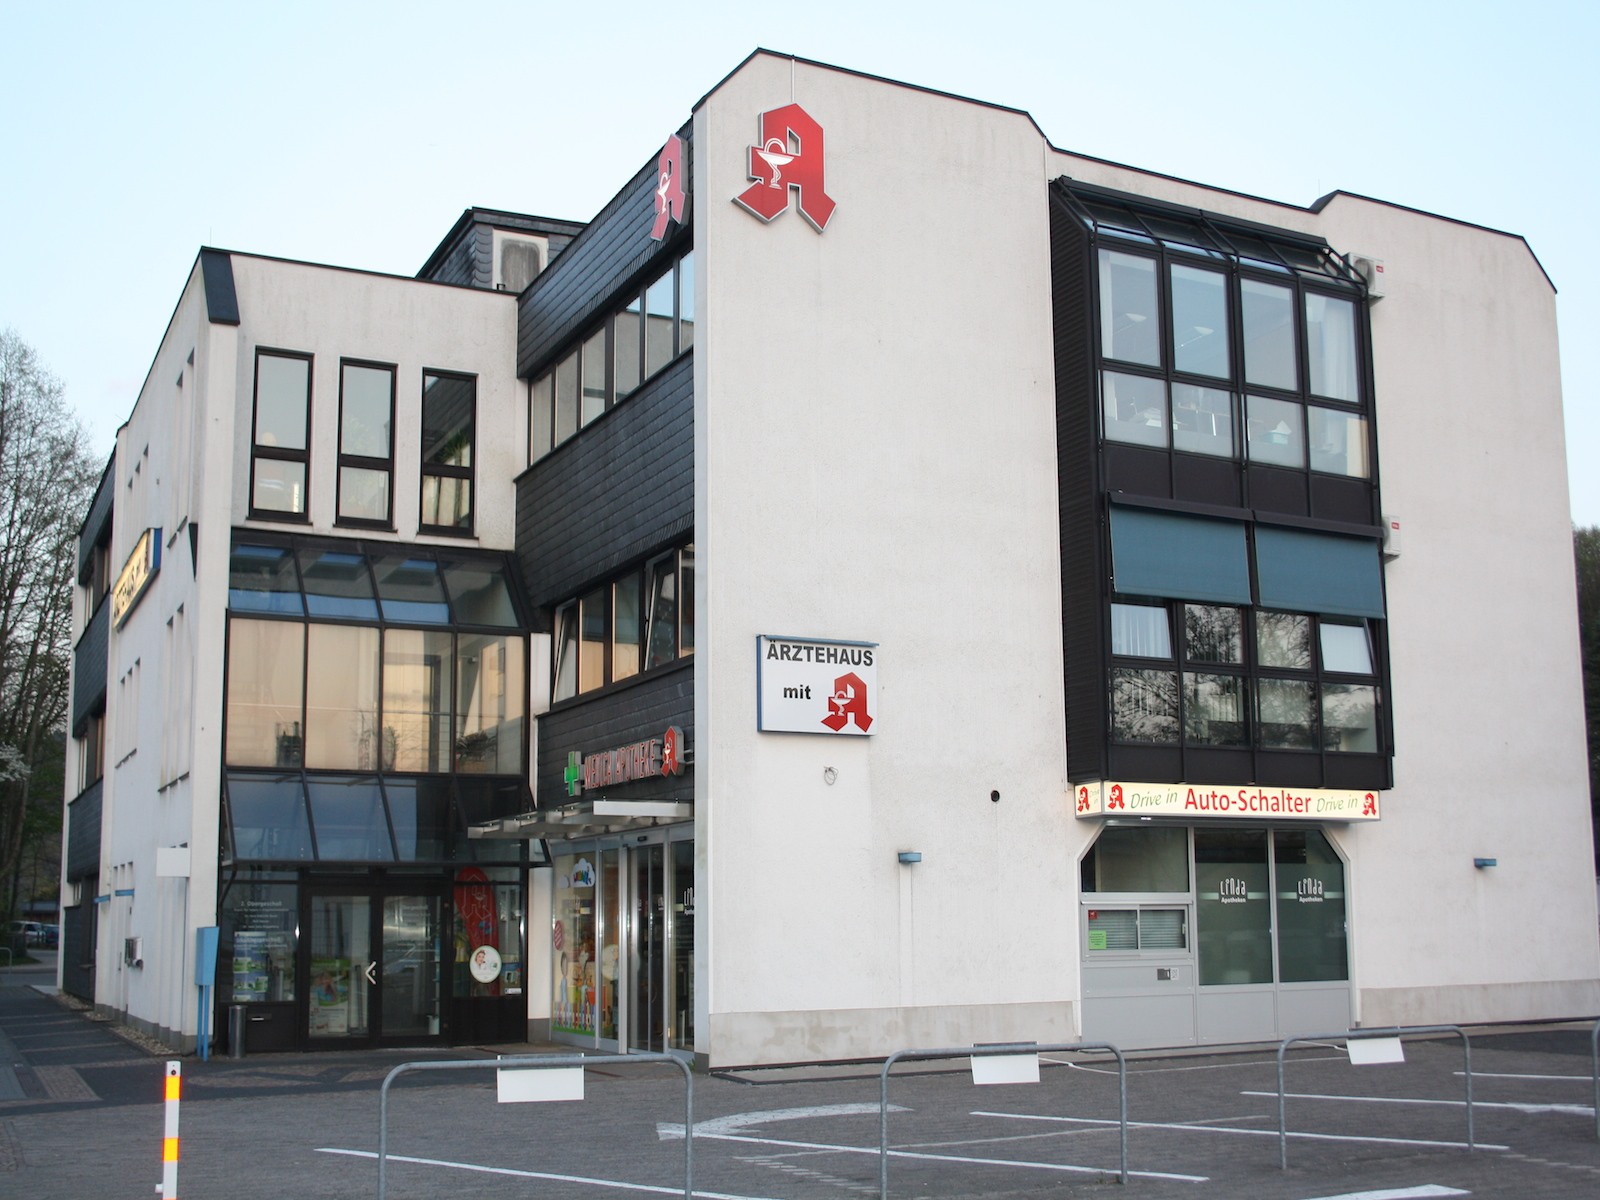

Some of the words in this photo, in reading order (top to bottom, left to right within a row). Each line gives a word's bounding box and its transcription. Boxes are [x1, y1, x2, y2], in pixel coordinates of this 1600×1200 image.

[766, 640, 874, 667] ÄRZTEHAUS
[783, 684, 812, 700] mit
[615, 739, 657, 784] APOTHEKE
[1130, 791, 1162, 809] Drive
[1166, 788, 1178, 804] in
[1184, 788, 1312, 813] Auto-Schalter
[1316, 795, 1344, 813] Drive
[1347, 794, 1358, 809] in
[1220, 896, 1247, 904] Apotheken
[1298, 896, 1324, 904] Apotheken
